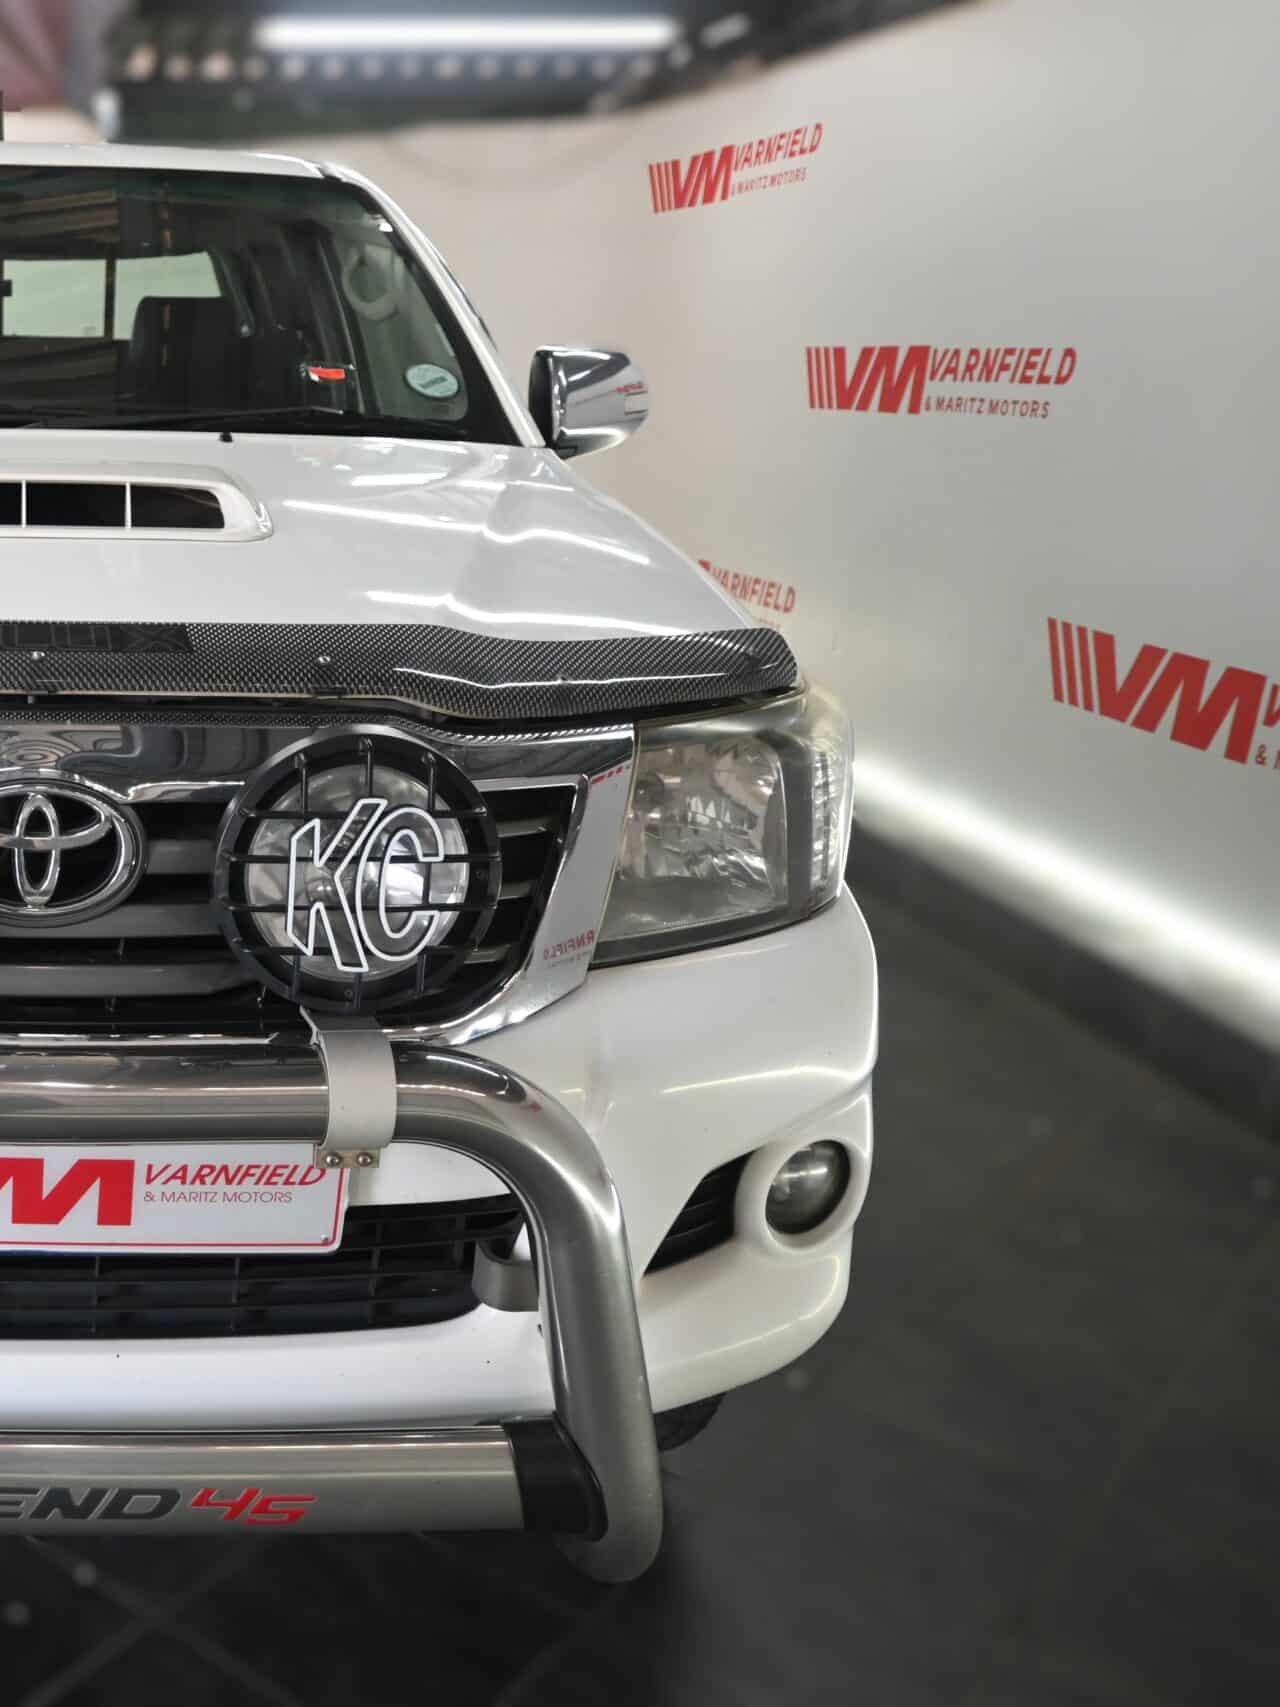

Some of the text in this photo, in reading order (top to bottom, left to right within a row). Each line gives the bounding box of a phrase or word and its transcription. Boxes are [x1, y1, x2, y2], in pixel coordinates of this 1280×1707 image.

[733, 122, 823, 172] VARNFIELD
[929, 347, 1077, 385] VARNFIELD
[936, 397, 985, 414] MARITZ
[987, 399, 1051, 419] MOTORS
[1255, 744, 1267, 766] &
[287, 798, 445, 972] KC
[144, 1163, 327, 1186] VARNFIELD
[144, 1191, 293, 1204] & MARITZ MOTORS
[191, 1487, 317, 1526] 45
